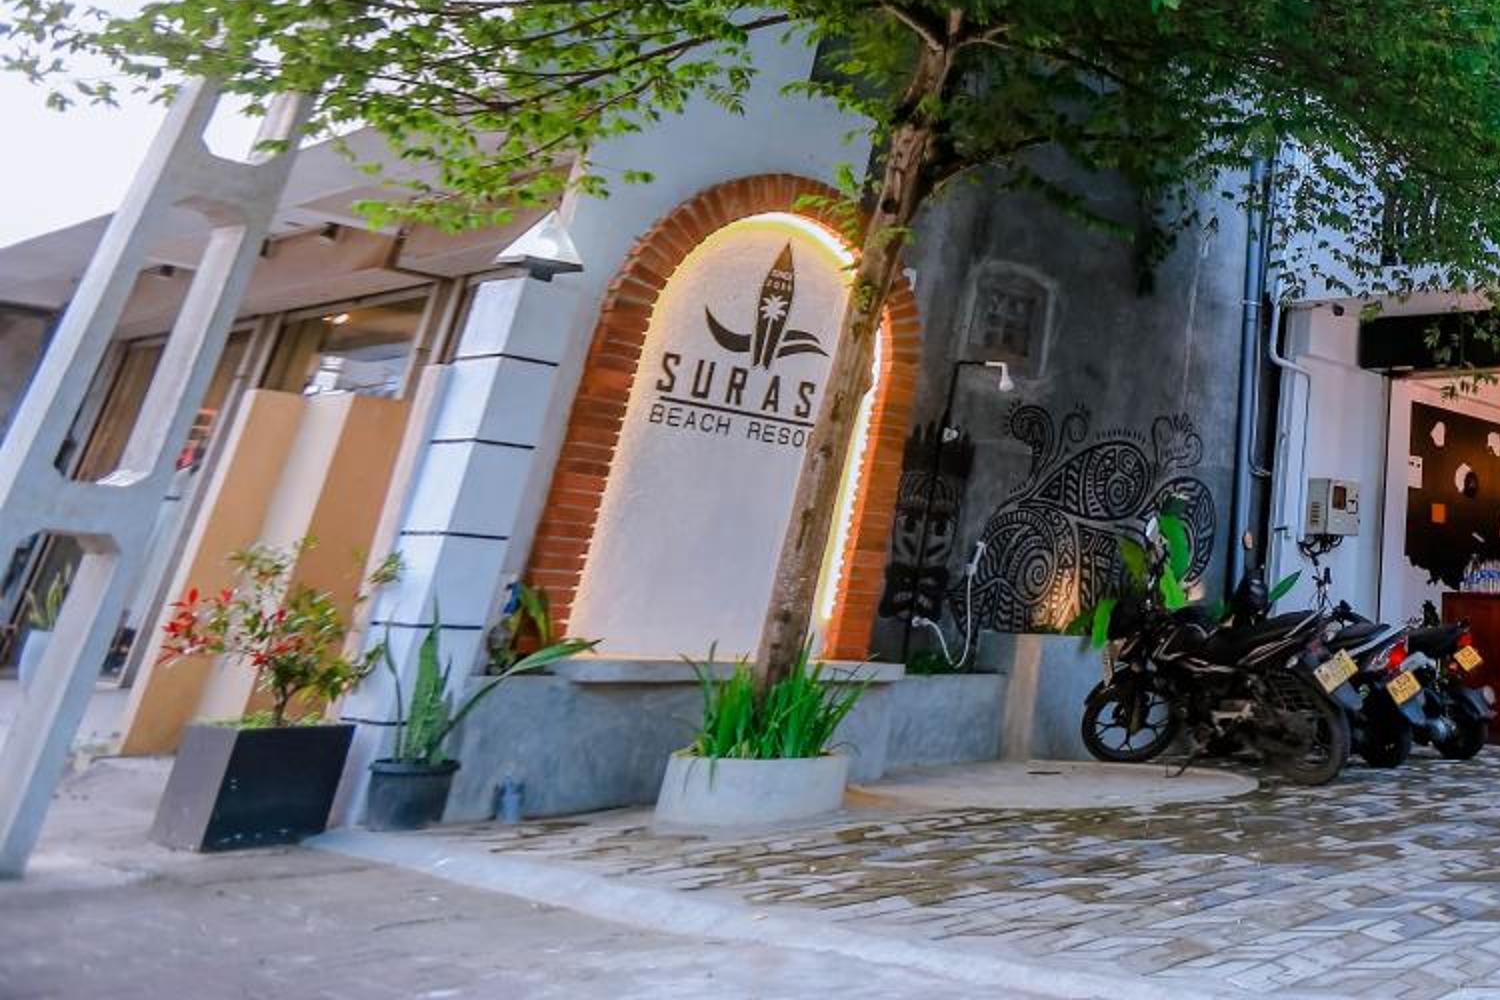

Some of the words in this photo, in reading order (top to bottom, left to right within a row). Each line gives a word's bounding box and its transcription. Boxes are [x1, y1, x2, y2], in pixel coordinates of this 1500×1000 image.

[656, 352, 816, 418] SURAS
[649, 403, 731, 436] BEACH
[747, 421, 807, 448] RESO
